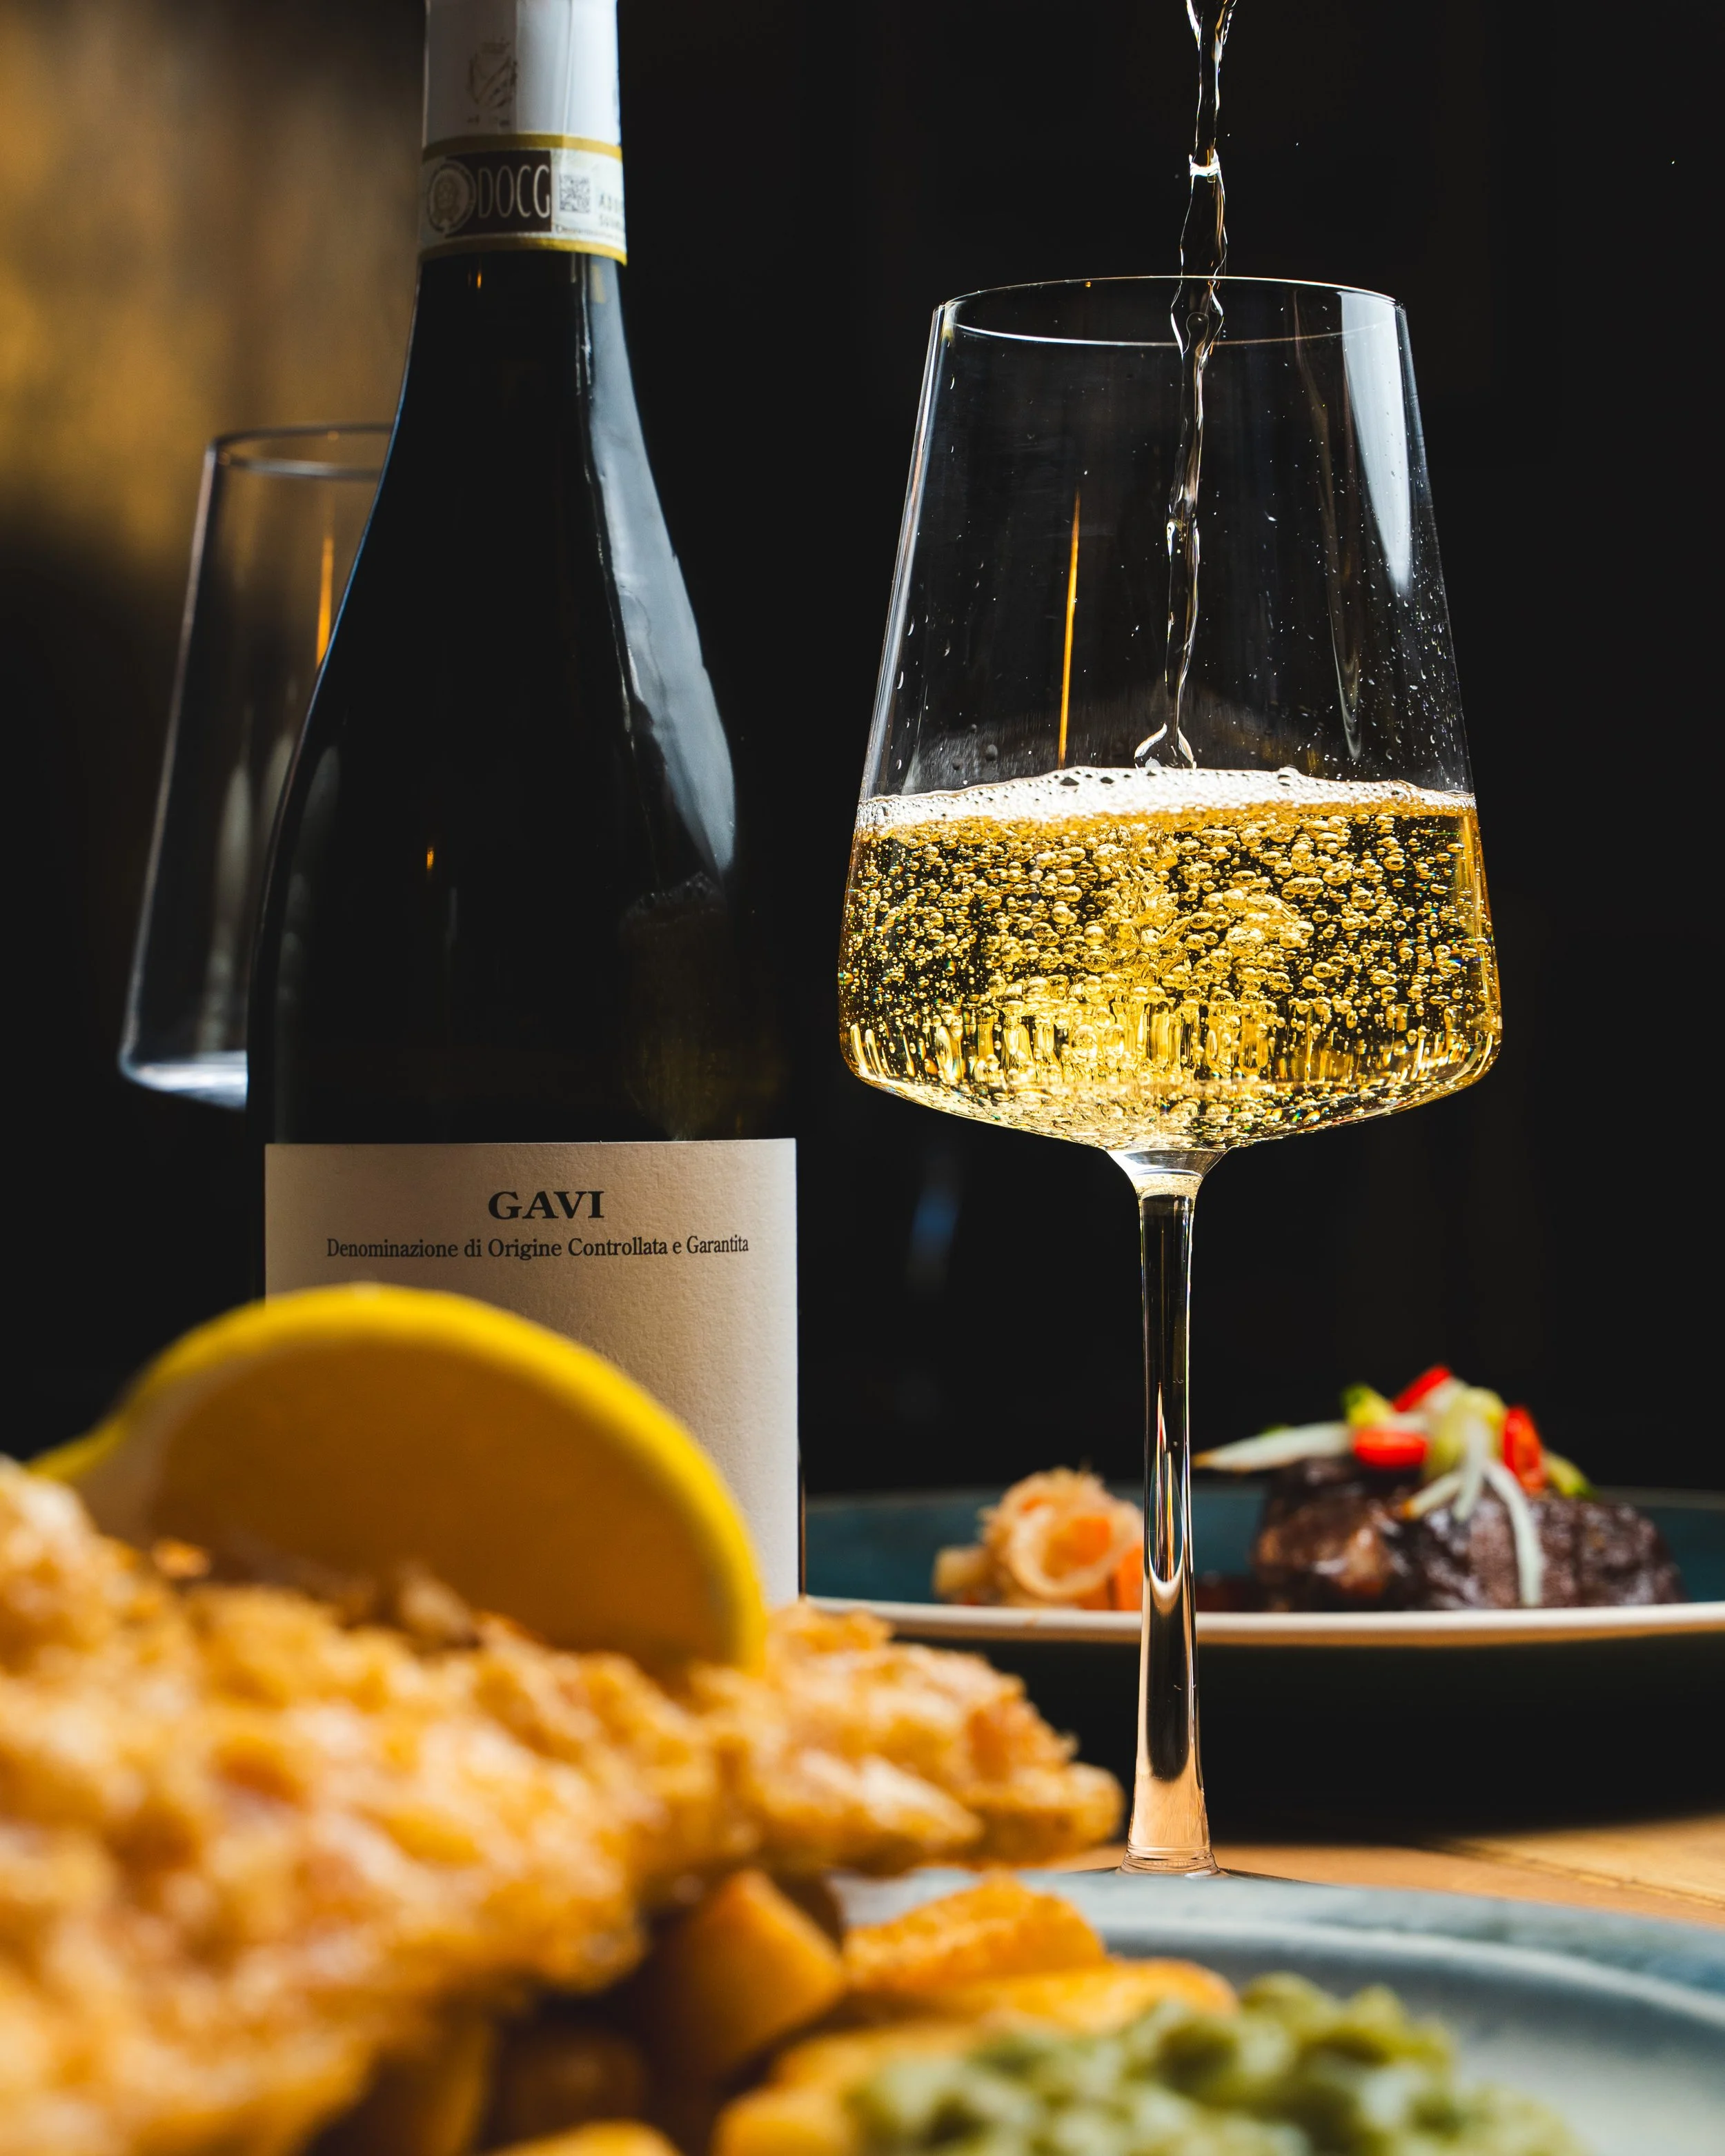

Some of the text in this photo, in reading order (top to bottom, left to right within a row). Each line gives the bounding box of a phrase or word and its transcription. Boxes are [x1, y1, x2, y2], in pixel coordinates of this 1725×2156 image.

[478, 164, 551, 219] DOCG
[488, 1190, 605, 1220] GAVI
[326, 1233, 750, 1261] Denominazione di Origine Controllata e Garantita
